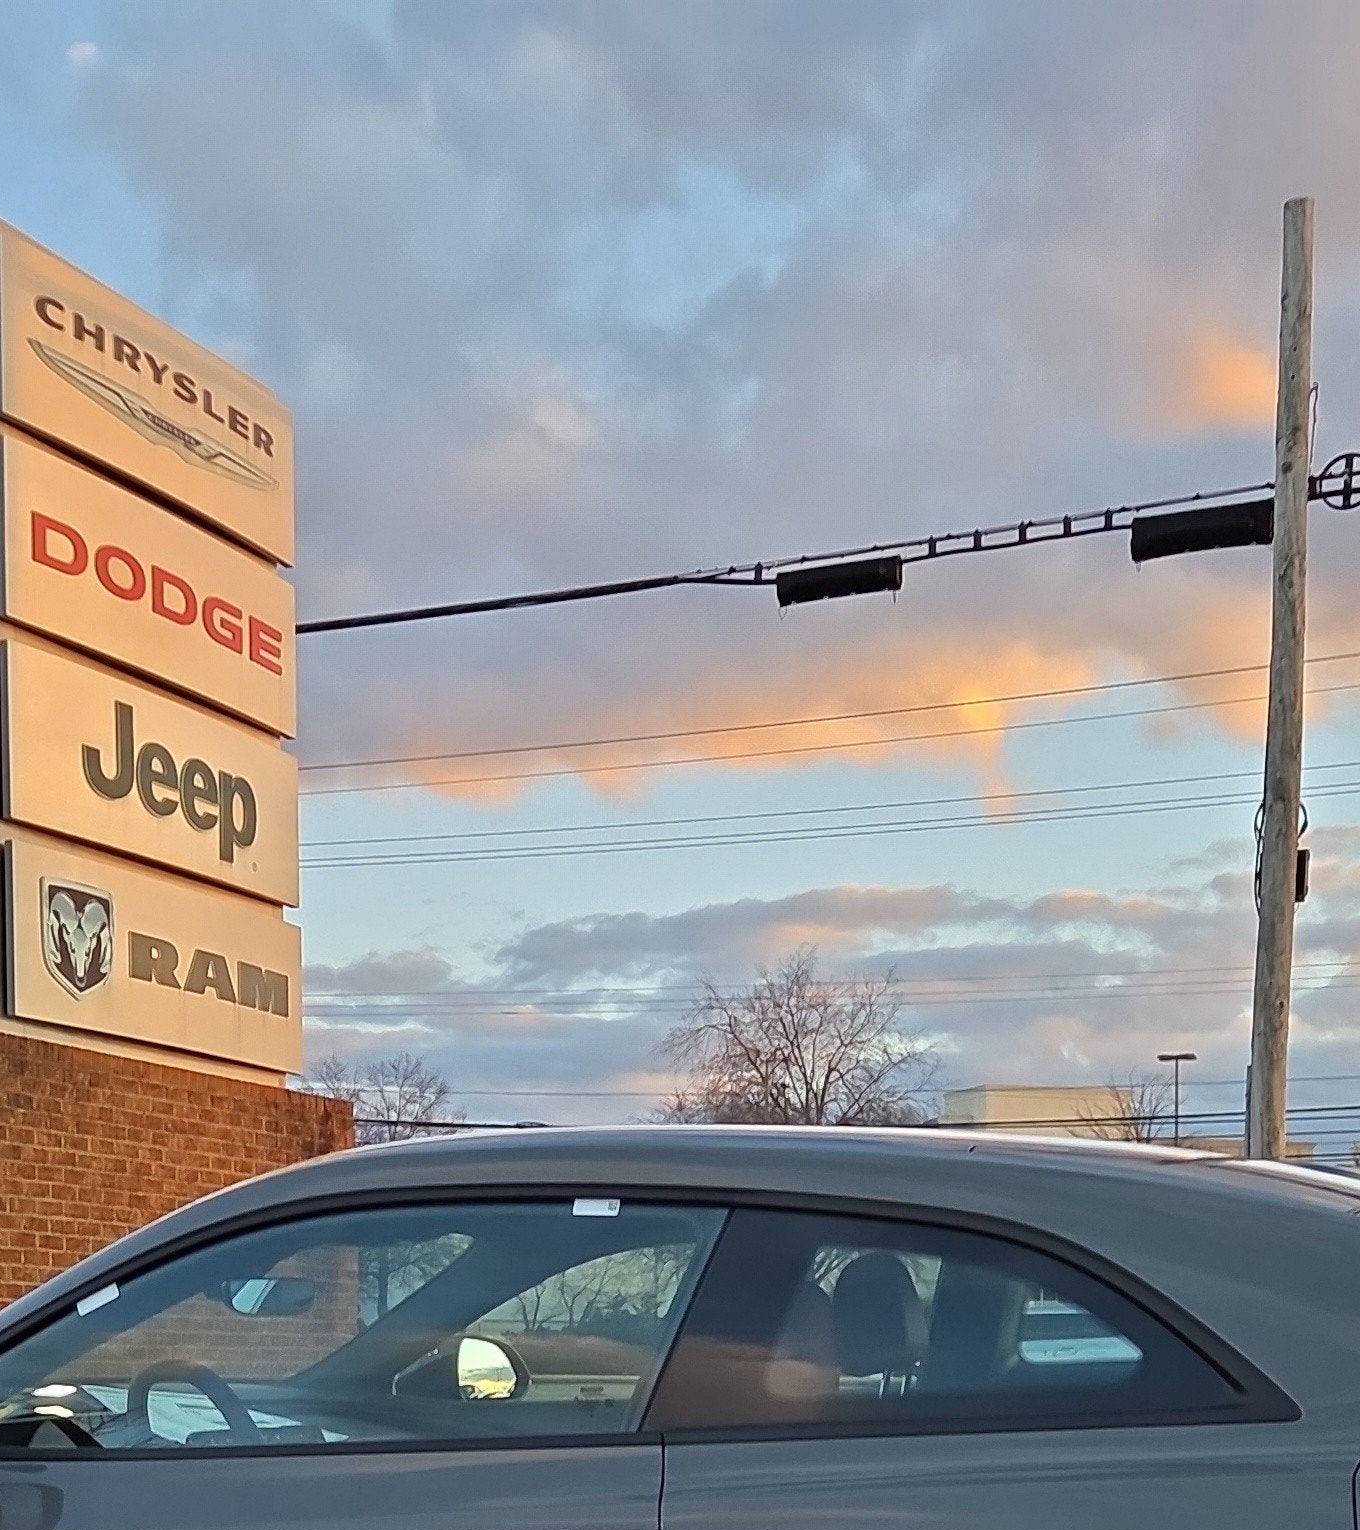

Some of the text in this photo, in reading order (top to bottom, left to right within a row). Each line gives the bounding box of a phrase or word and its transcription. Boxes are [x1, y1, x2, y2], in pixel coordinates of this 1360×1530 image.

[34, 295, 275, 458] CHRYSLER
[30, 509, 283, 677] DODGE
[81, 699, 258, 864] Jeep
[127, 930, 290, 1018] RAM
